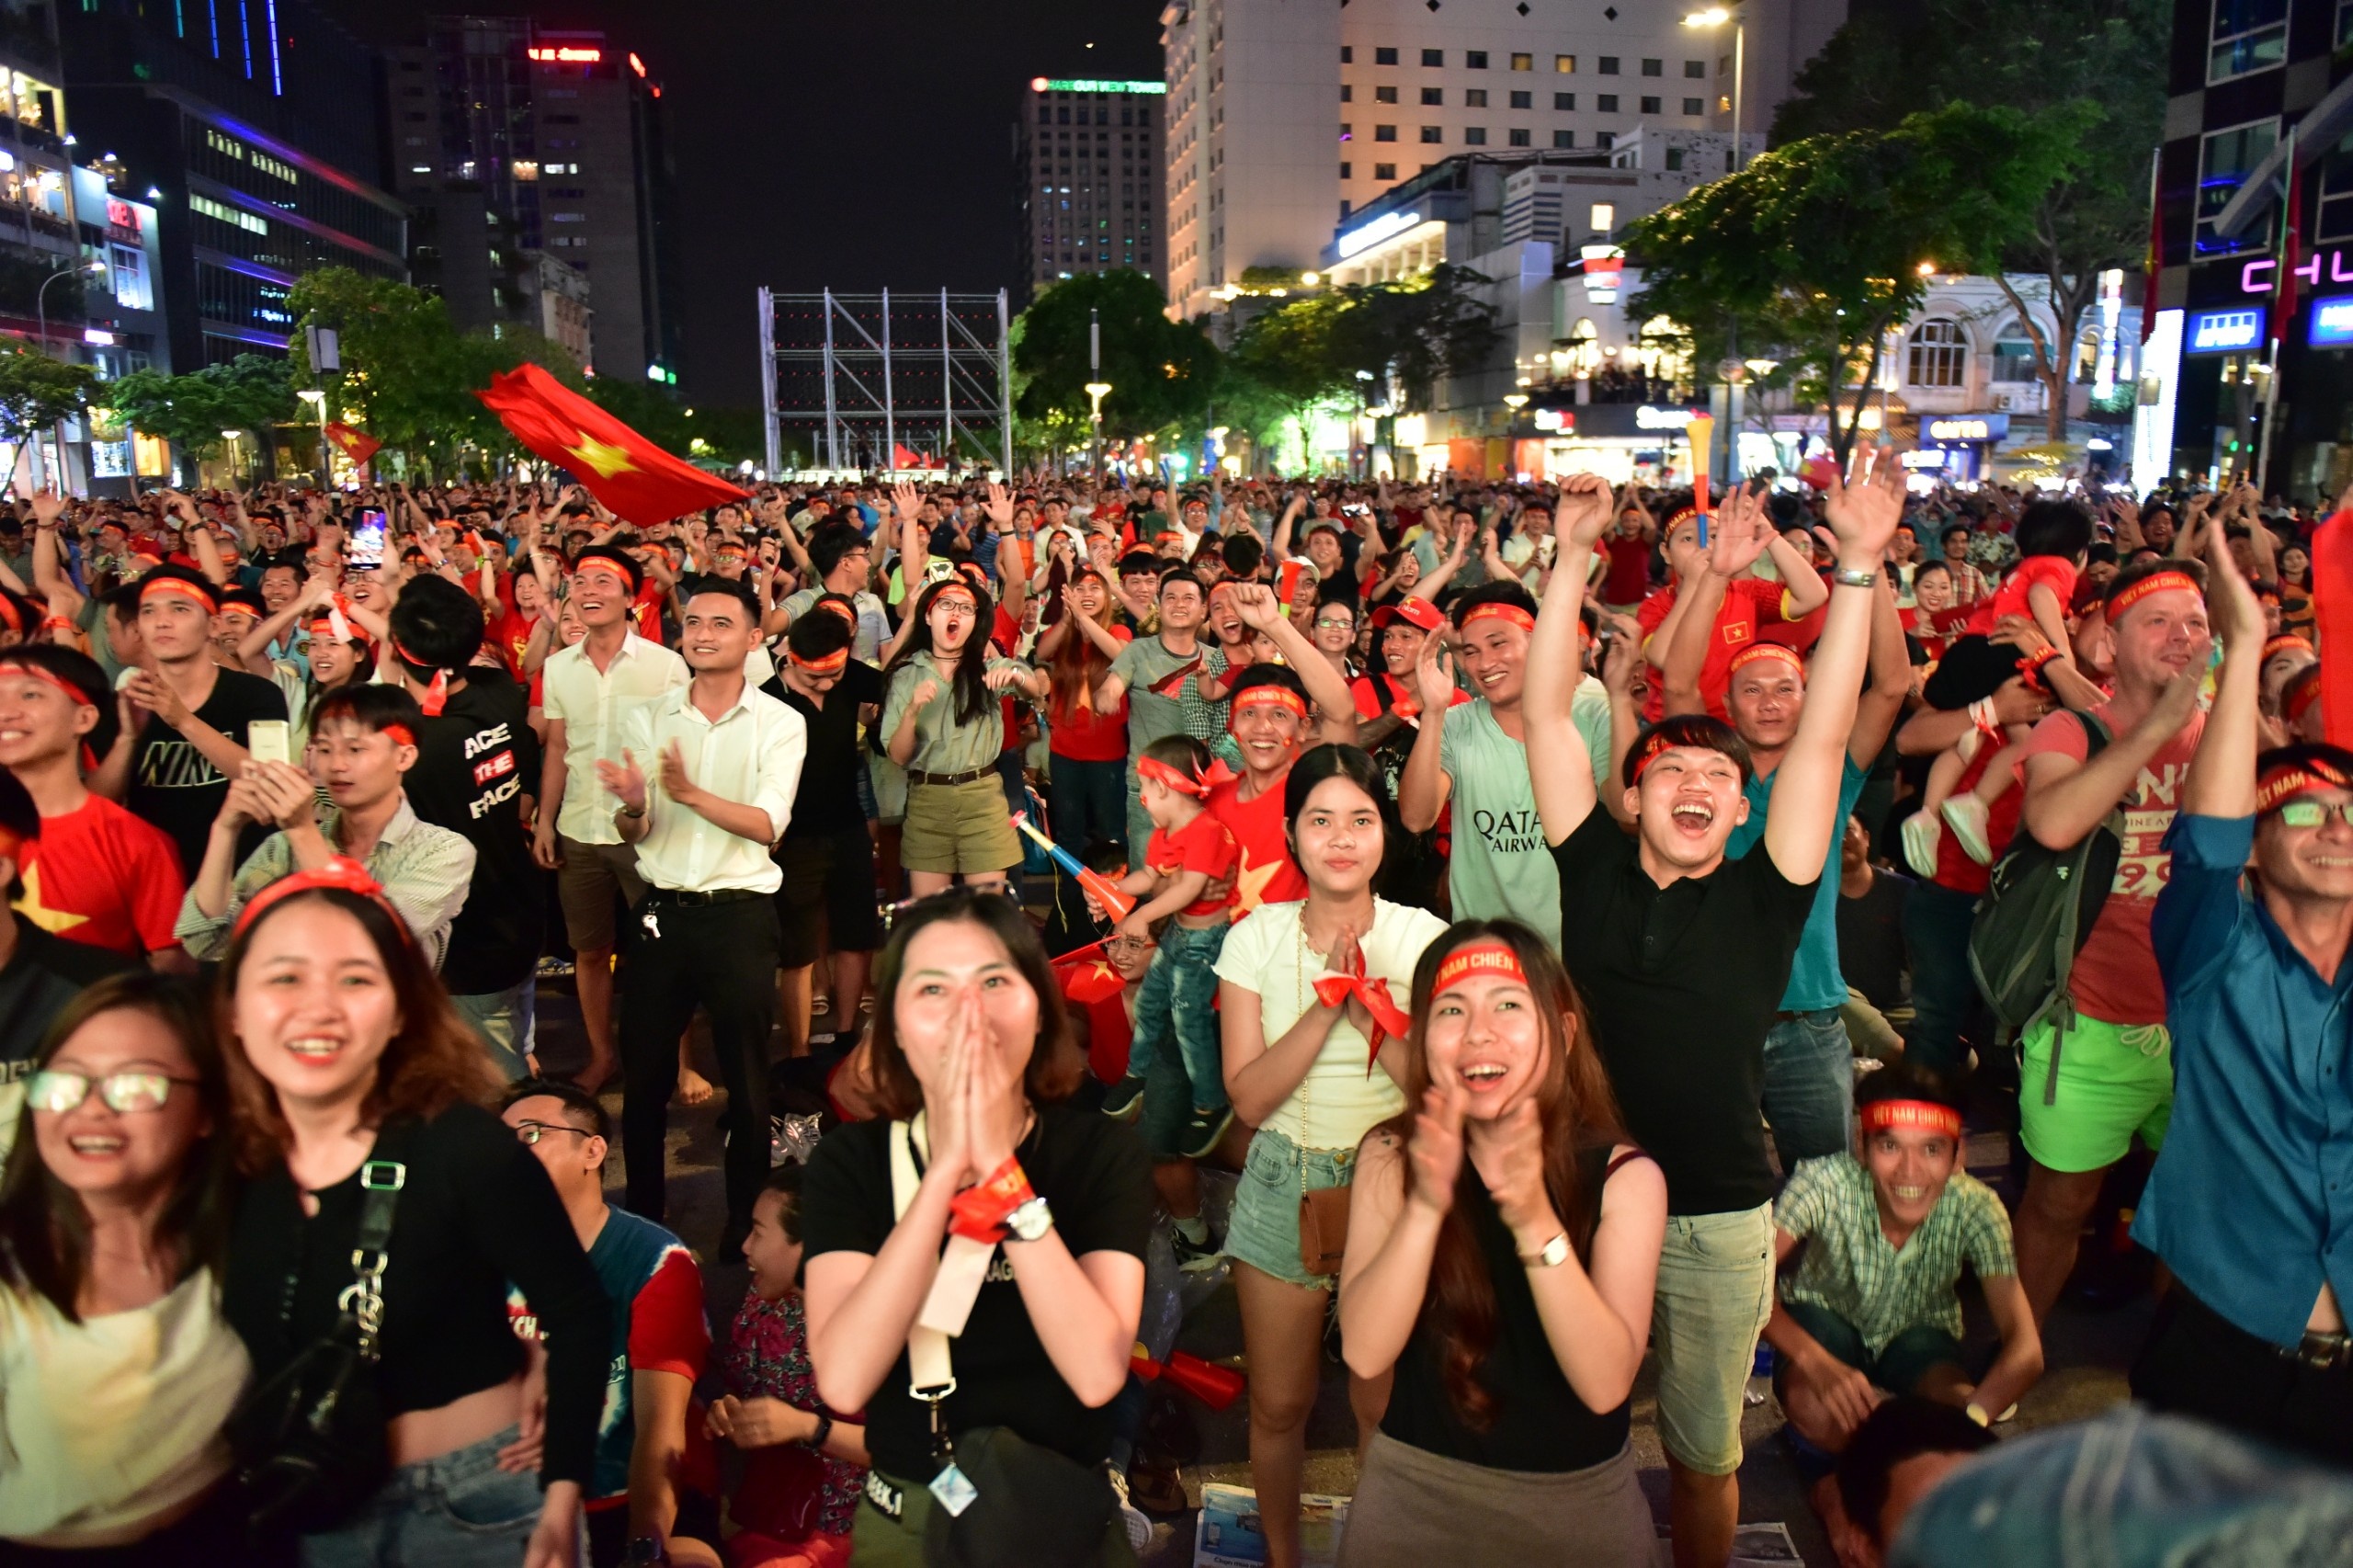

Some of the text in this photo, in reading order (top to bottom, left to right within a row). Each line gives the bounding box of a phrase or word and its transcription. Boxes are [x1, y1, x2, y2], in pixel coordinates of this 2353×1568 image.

[1048, 79, 1167, 94] HARBOUR VIEW TOWER
[2138, 578, 2159, 595] NAM
[464, 722, 512, 759] ACE
[473, 753, 514, 781] THE
[2272, 771, 2305, 797] NAM
[1473, 810, 1542, 841] QATA
[1492, 835, 1548, 853] AIRWA
[1440, 956, 1468, 982] NAM
[1893, 1106, 1915, 1125] NAM
